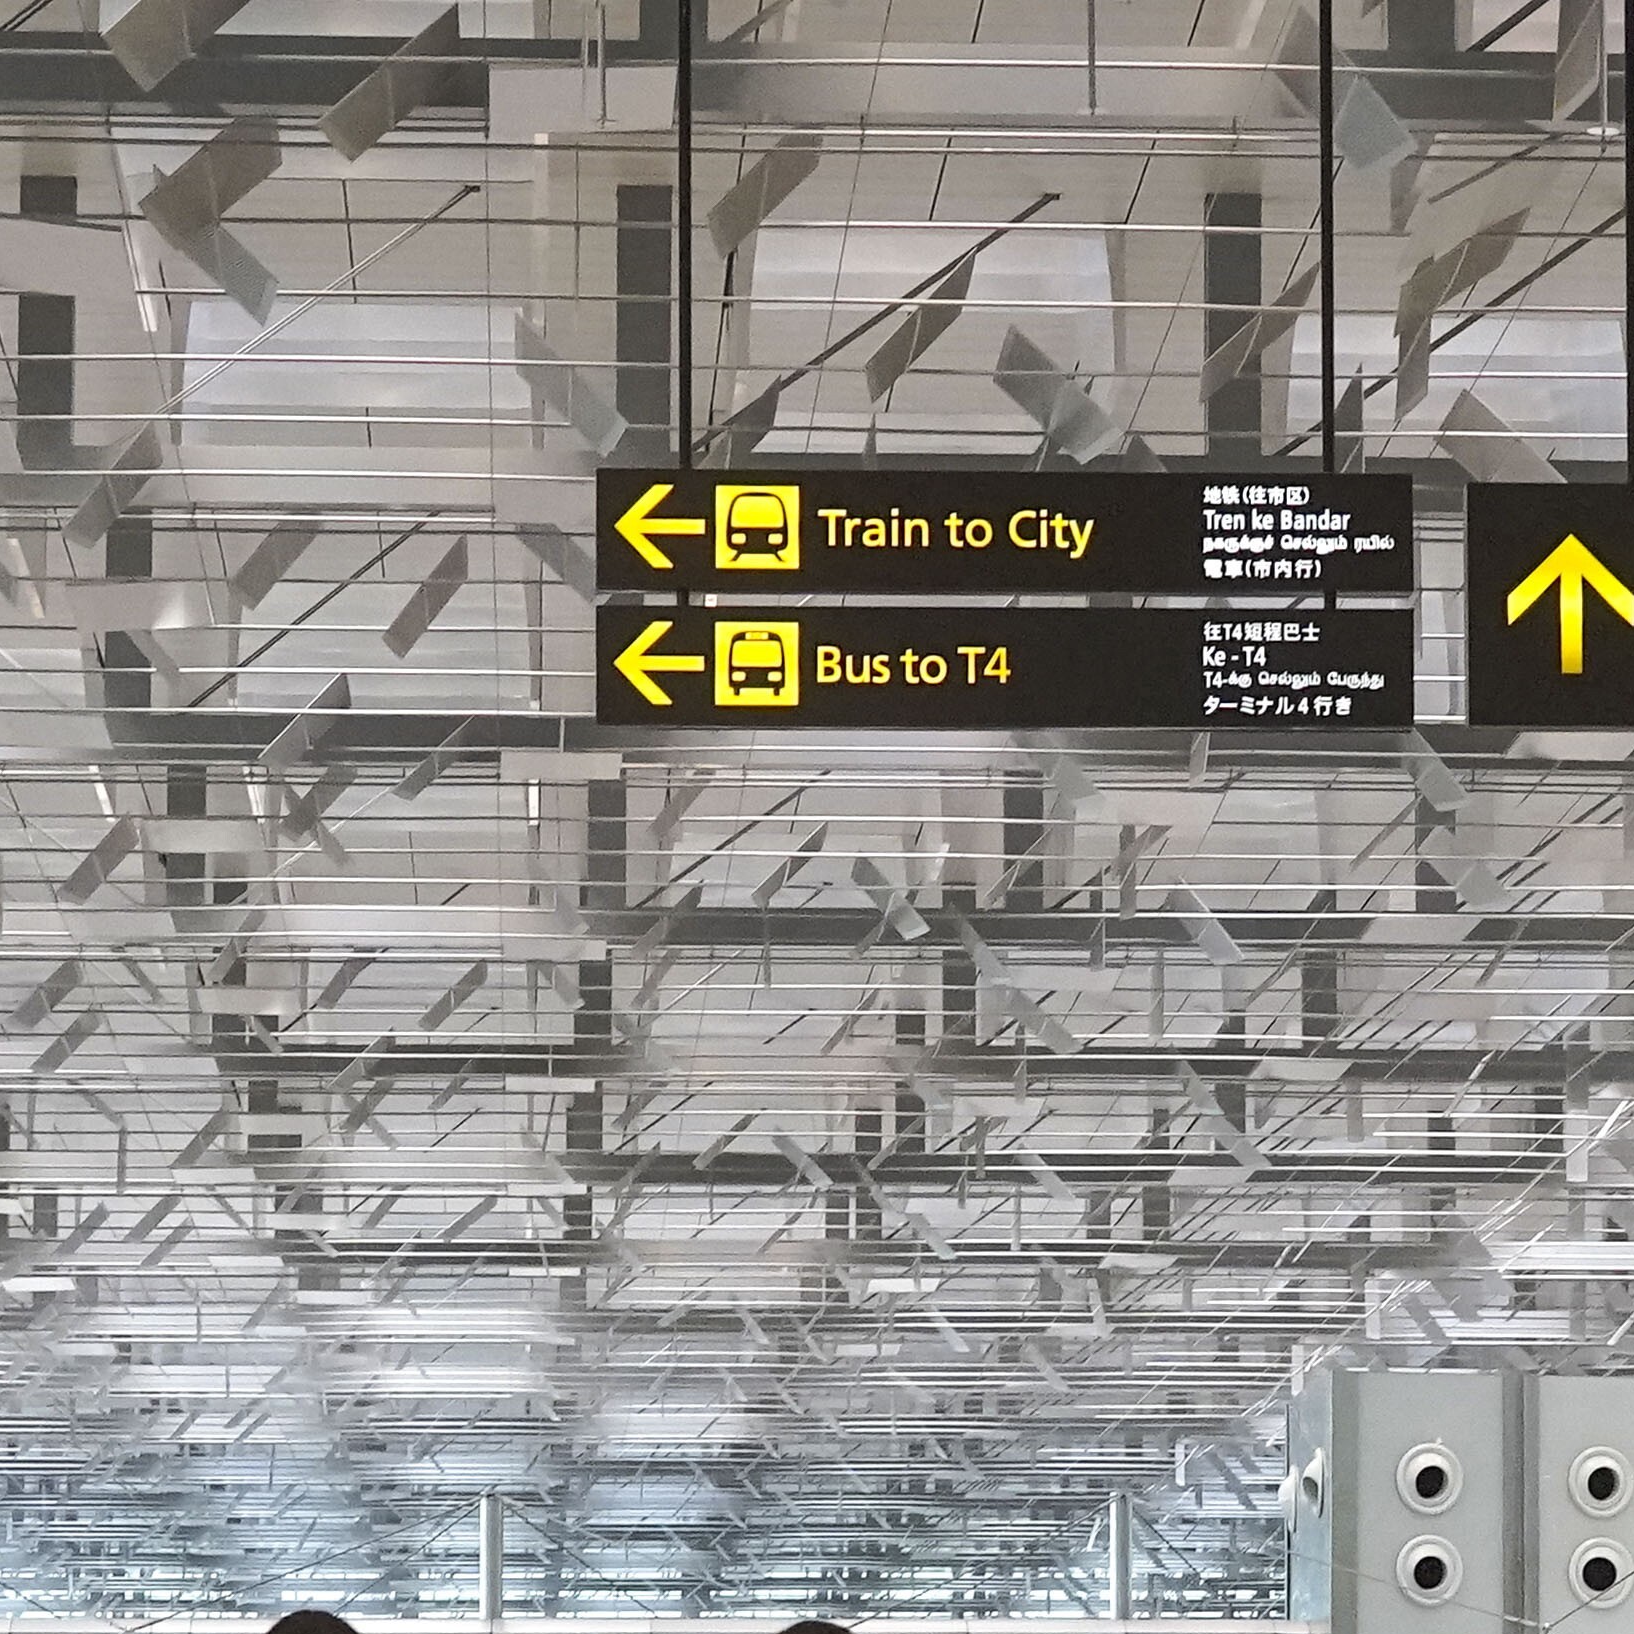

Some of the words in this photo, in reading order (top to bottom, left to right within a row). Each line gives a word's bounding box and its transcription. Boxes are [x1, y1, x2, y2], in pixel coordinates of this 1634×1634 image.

[1202, 509, 1246, 530] Tren
[1251, 507, 1275, 531] ke
[1280, 508, 1351, 531] Bandar
[817, 507, 930, 547] Train
[943, 512, 993, 548] to
[1008, 509, 1095, 559] City
[1203, 621, 1321, 642] 往T4短程巴士
[816, 645, 891, 684] Bus
[899, 648, 948, 685] to
[956, 646, 1012, 684] T4
[1202, 645, 1227, 667] Ke
[1242, 645, 1267, 667] T4
